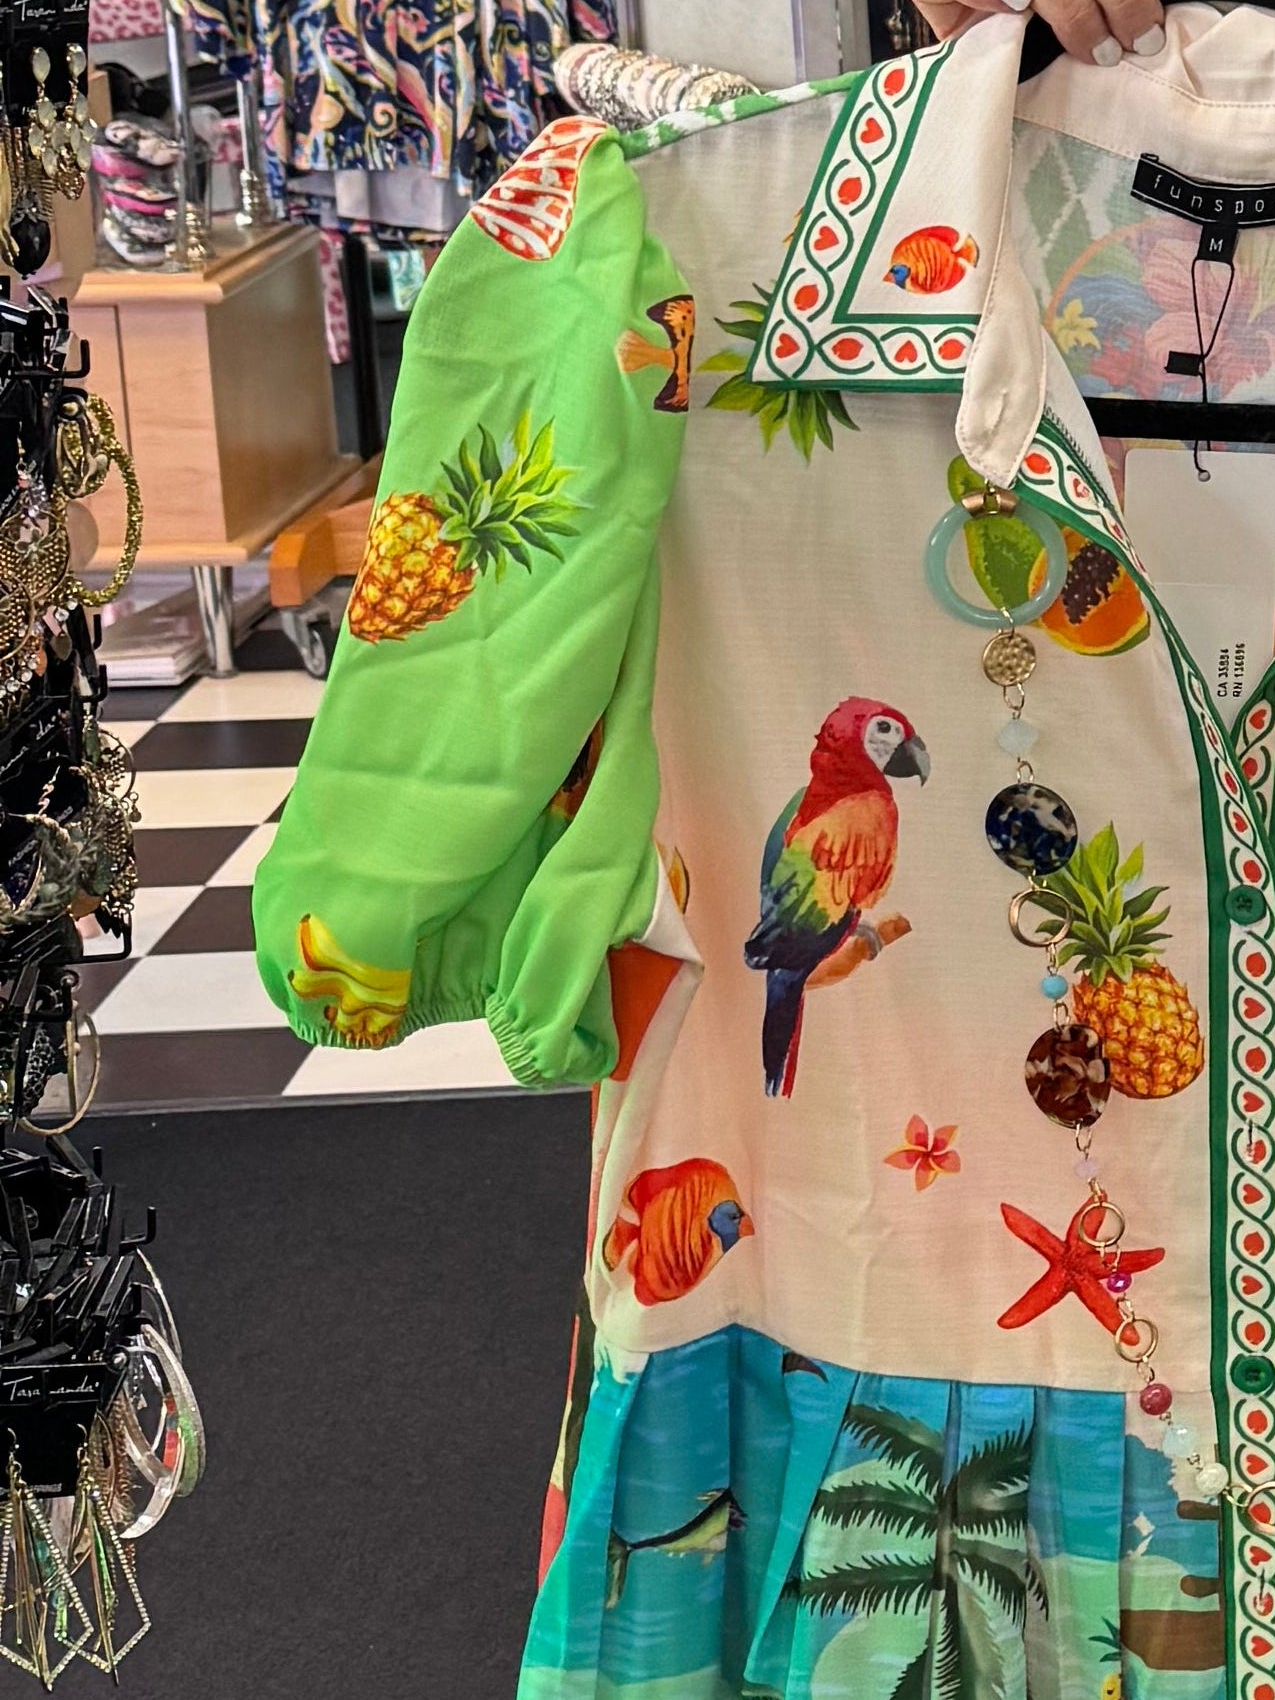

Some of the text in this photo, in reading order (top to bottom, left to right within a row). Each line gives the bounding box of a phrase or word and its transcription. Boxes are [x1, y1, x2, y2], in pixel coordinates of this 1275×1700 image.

[1209, 238, 1223, 252] M
[1217, 682, 1228, 697] CA
[1232, 682, 1243, 697] RN
